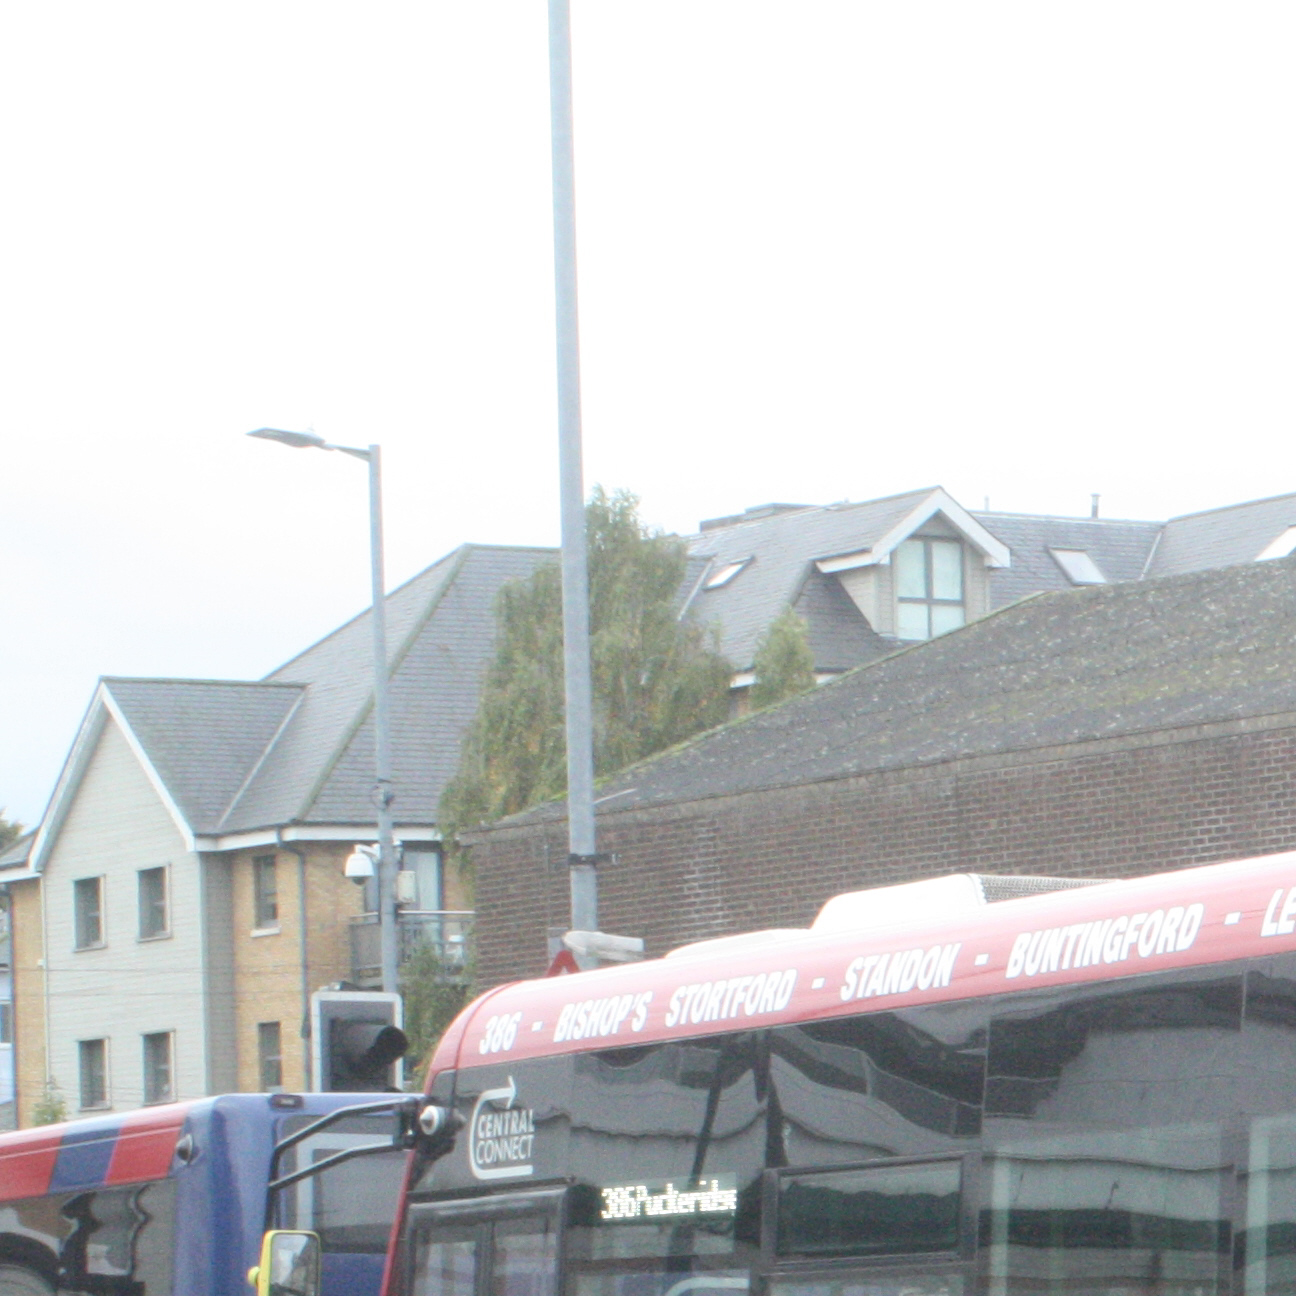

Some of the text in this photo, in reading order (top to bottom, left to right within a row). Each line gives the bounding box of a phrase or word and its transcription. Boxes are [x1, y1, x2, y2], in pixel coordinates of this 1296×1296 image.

[479, 1012, 520, 1054] 386
[554, 992, 653, 1042] BISHOP'S
[665, 970, 796, 1027] STORTFORD
[841, 943, 962, 1001] STANDON
[1006, 903, 1204, 979] BUNTINGFORD
[477, 1109, 534, 1139] CENTRAL
[476, 1134, 534, 1165] CONNECT
